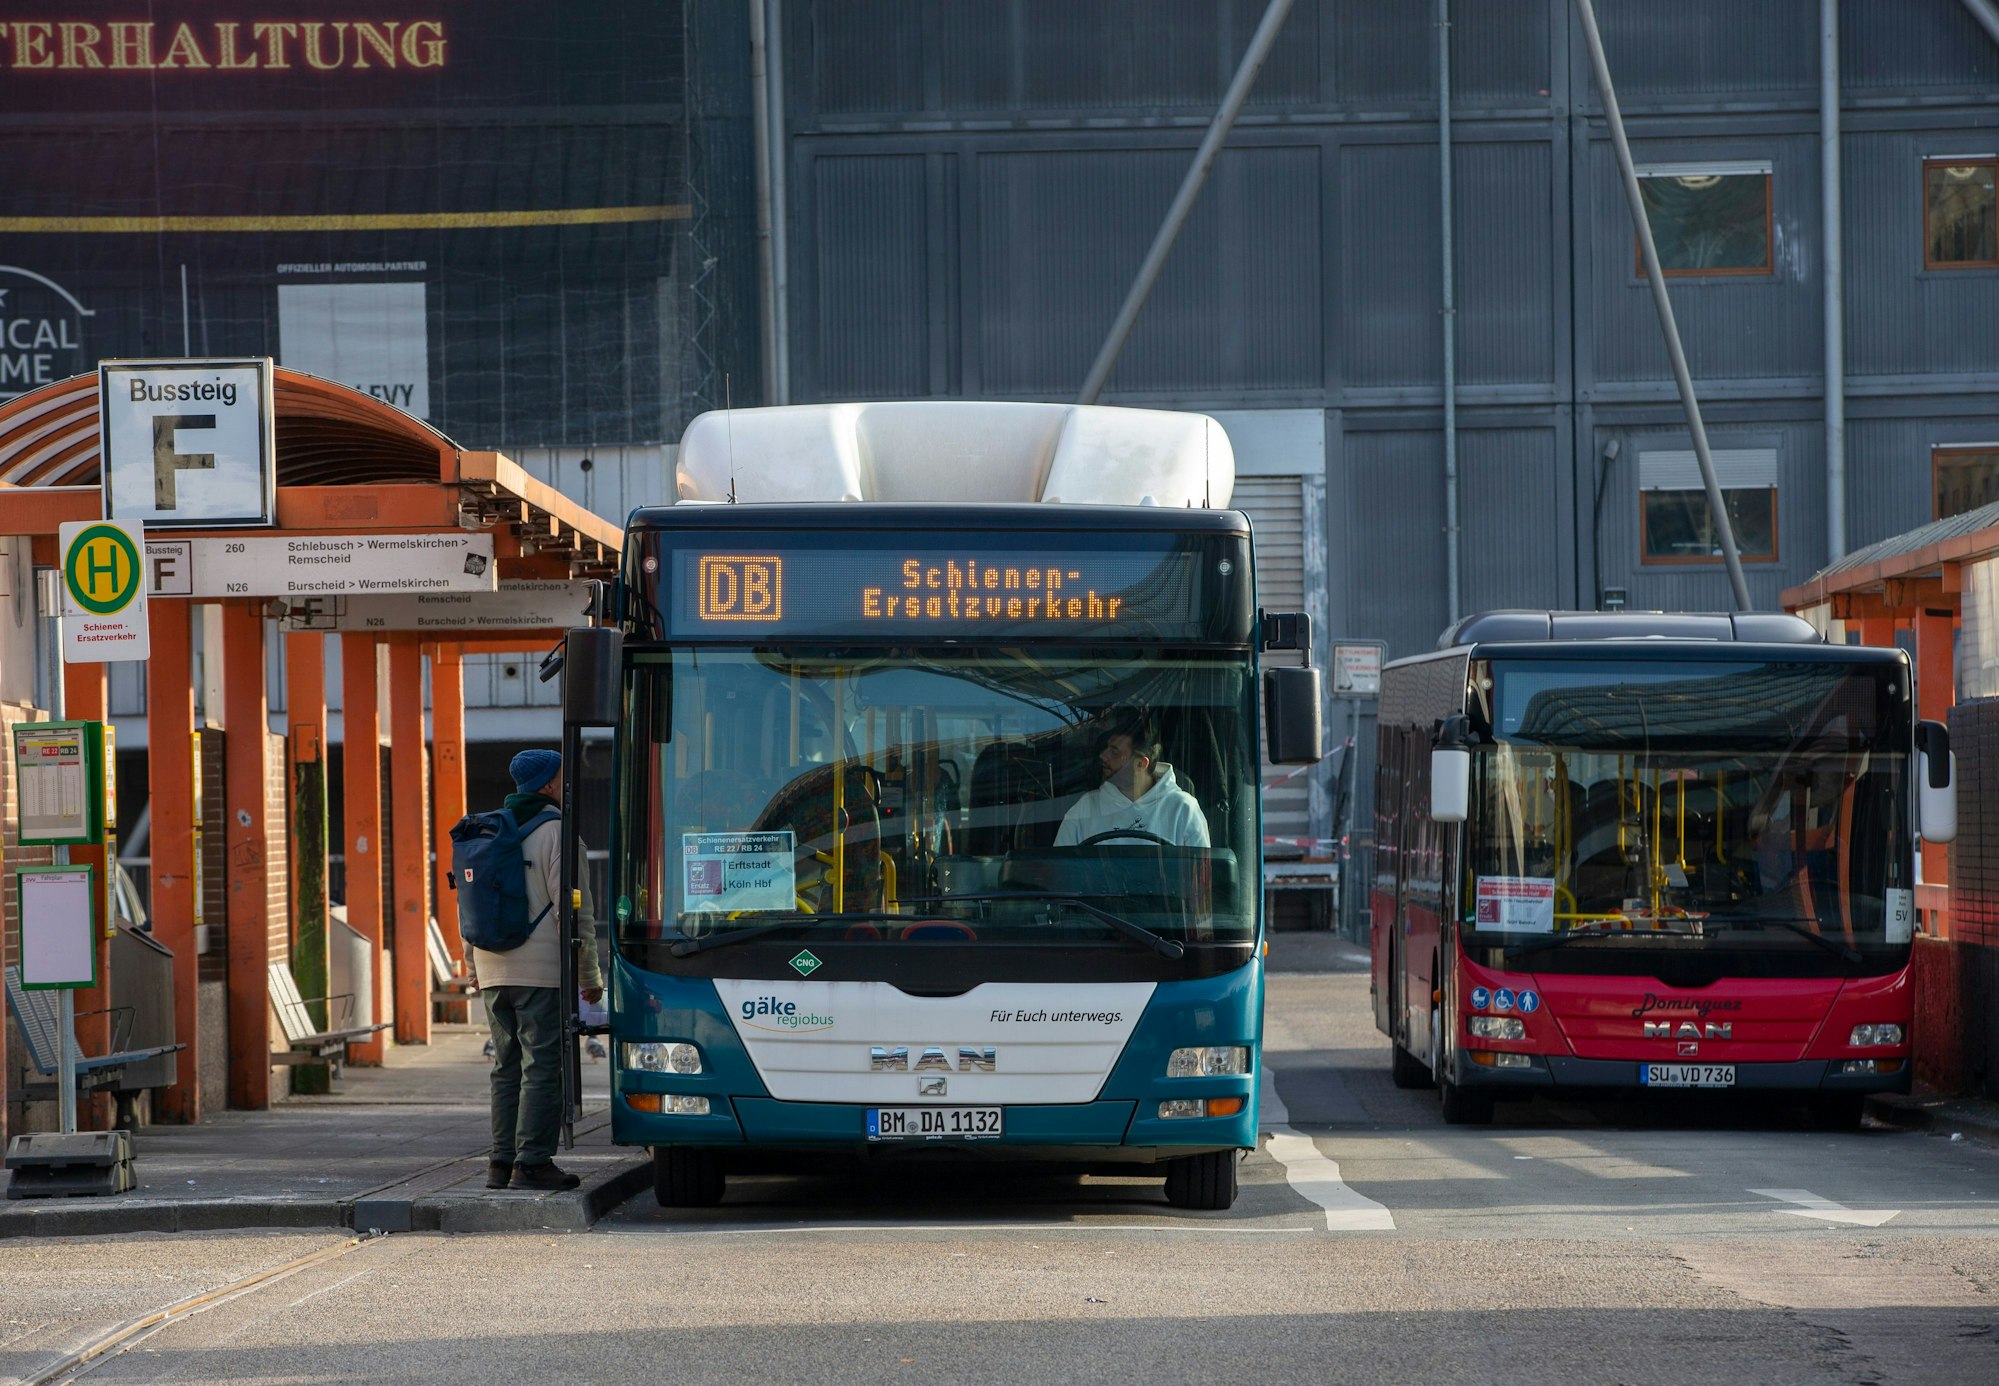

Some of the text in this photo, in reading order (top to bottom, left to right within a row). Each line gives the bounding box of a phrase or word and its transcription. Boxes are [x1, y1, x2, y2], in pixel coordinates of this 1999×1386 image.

[277, 261, 427, 273] OFFIZIELLER AUTOMOBILPARTNER
[130, 377, 237, 406] Bussteig
[152, 414, 216, 510] F
[146, 545, 183, 556] Bussteig
[225, 543, 245, 553] 260
[288, 541, 354, 551] Schlebusch
[367, 539, 458, 550] Wermelskirchen
[288, 554, 351, 564] Remscheid
[87, 545, 118, 594] H
[154, 558, 175, 590] F
[903, 559, 1080, 589] Schienen-
[227, 583, 249, 592] N26
[288, 580, 345, 590] Burscheid
[358, 578, 449, 589] Wermelskirchen
[498, 582, 561, 591] rmelskirchen
[708, 562, 772, 614] DB
[418, 595, 471, 604] Remscheid
[863, 588, 1121, 618] Ersatzverkehr
[83, 623, 123, 632] Schienen
[366, 618, 385, 626] N26
[418, 616, 466, 625] Burscheid
[477, 615, 553, 625] Wermelskirchen
[77, 632, 136, 642] Ersatzverkehr
[42, 747, 50, 755] RE
[697, 835, 779, 845] Schienenersatzverkehr
[686, 846, 698, 855] DB
[728, 860, 771, 870] Erftstadt
[728, 879, 772, 889] Köln Hbf
[1895, 910, 1908, 922] 5V
[796, 959, 815, 967] CNG
[742, 996, 796, 1020] gäke
[777, 1013, 834, 1028] regiobus
[990, 1009, 1123, 1025] Für Euch unterwegs.
[1643, 1021, 1732, 1039] MAN
[870, 1047, 996, 1071] MAN
[1649, 1066, 1733, 1083] SU VD 736
[881, 1111, 999, 1132] BM DA 1132
